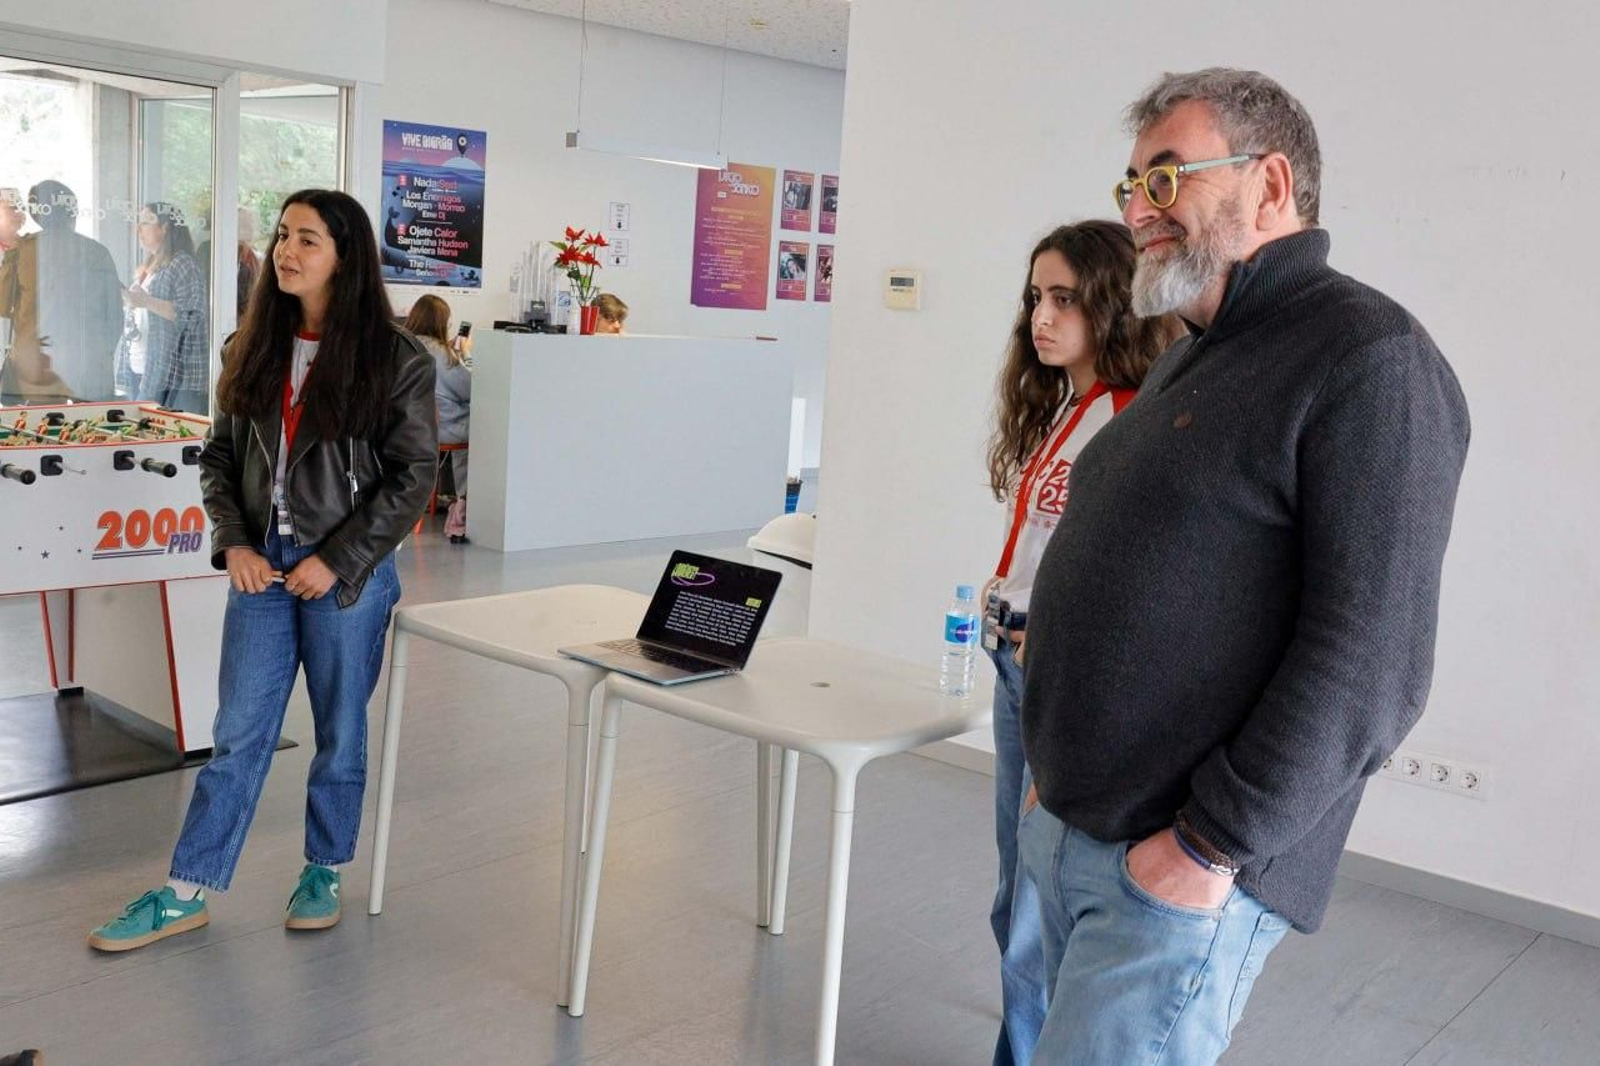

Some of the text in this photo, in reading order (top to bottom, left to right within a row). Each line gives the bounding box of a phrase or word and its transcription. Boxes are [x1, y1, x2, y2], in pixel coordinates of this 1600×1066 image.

[414, 176, 436, 188] Nada
[406, 190, 421, 199] Los
[409, 226, 432, 238] Ojete
[434, 227, 458, 238] Calor
[397, 235, 469, 249] Samantha Hudson
[407, 245, 436, 255] Javiera
[409, 259, 424, 268] The
[94, 506, 205, 551] 2000
[167, 532, 203, 554] PRO
